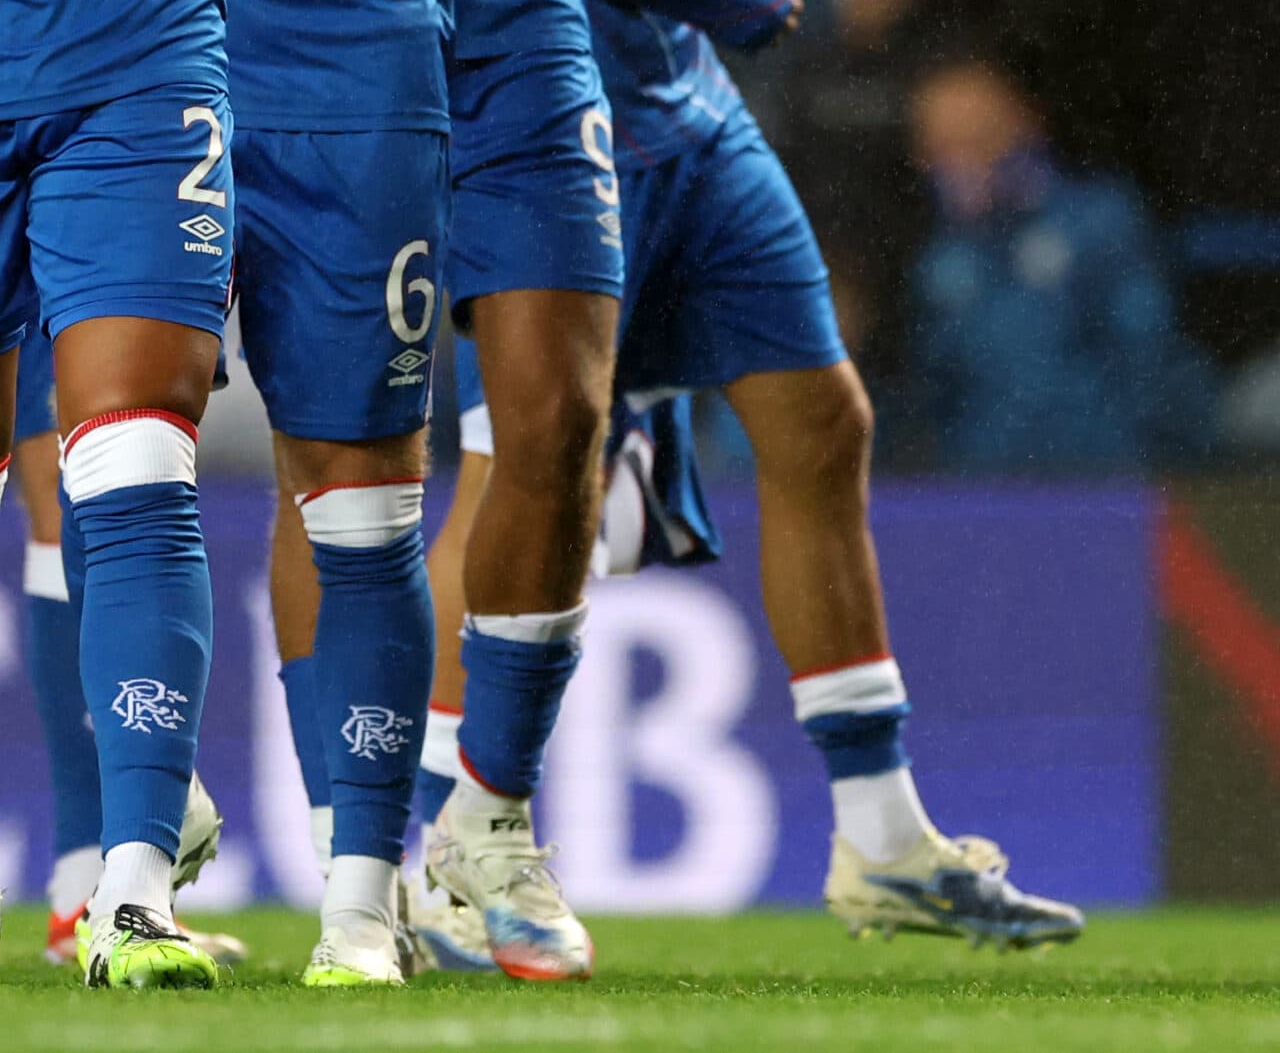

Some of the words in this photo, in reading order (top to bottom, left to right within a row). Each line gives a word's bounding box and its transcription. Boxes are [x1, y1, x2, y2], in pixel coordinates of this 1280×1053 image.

[178, 106, 226, 208] 2
[581, 110, 620, 206] 9
[184, 241, 223, 256] umbro
[386, 239, 435, 344] 6
